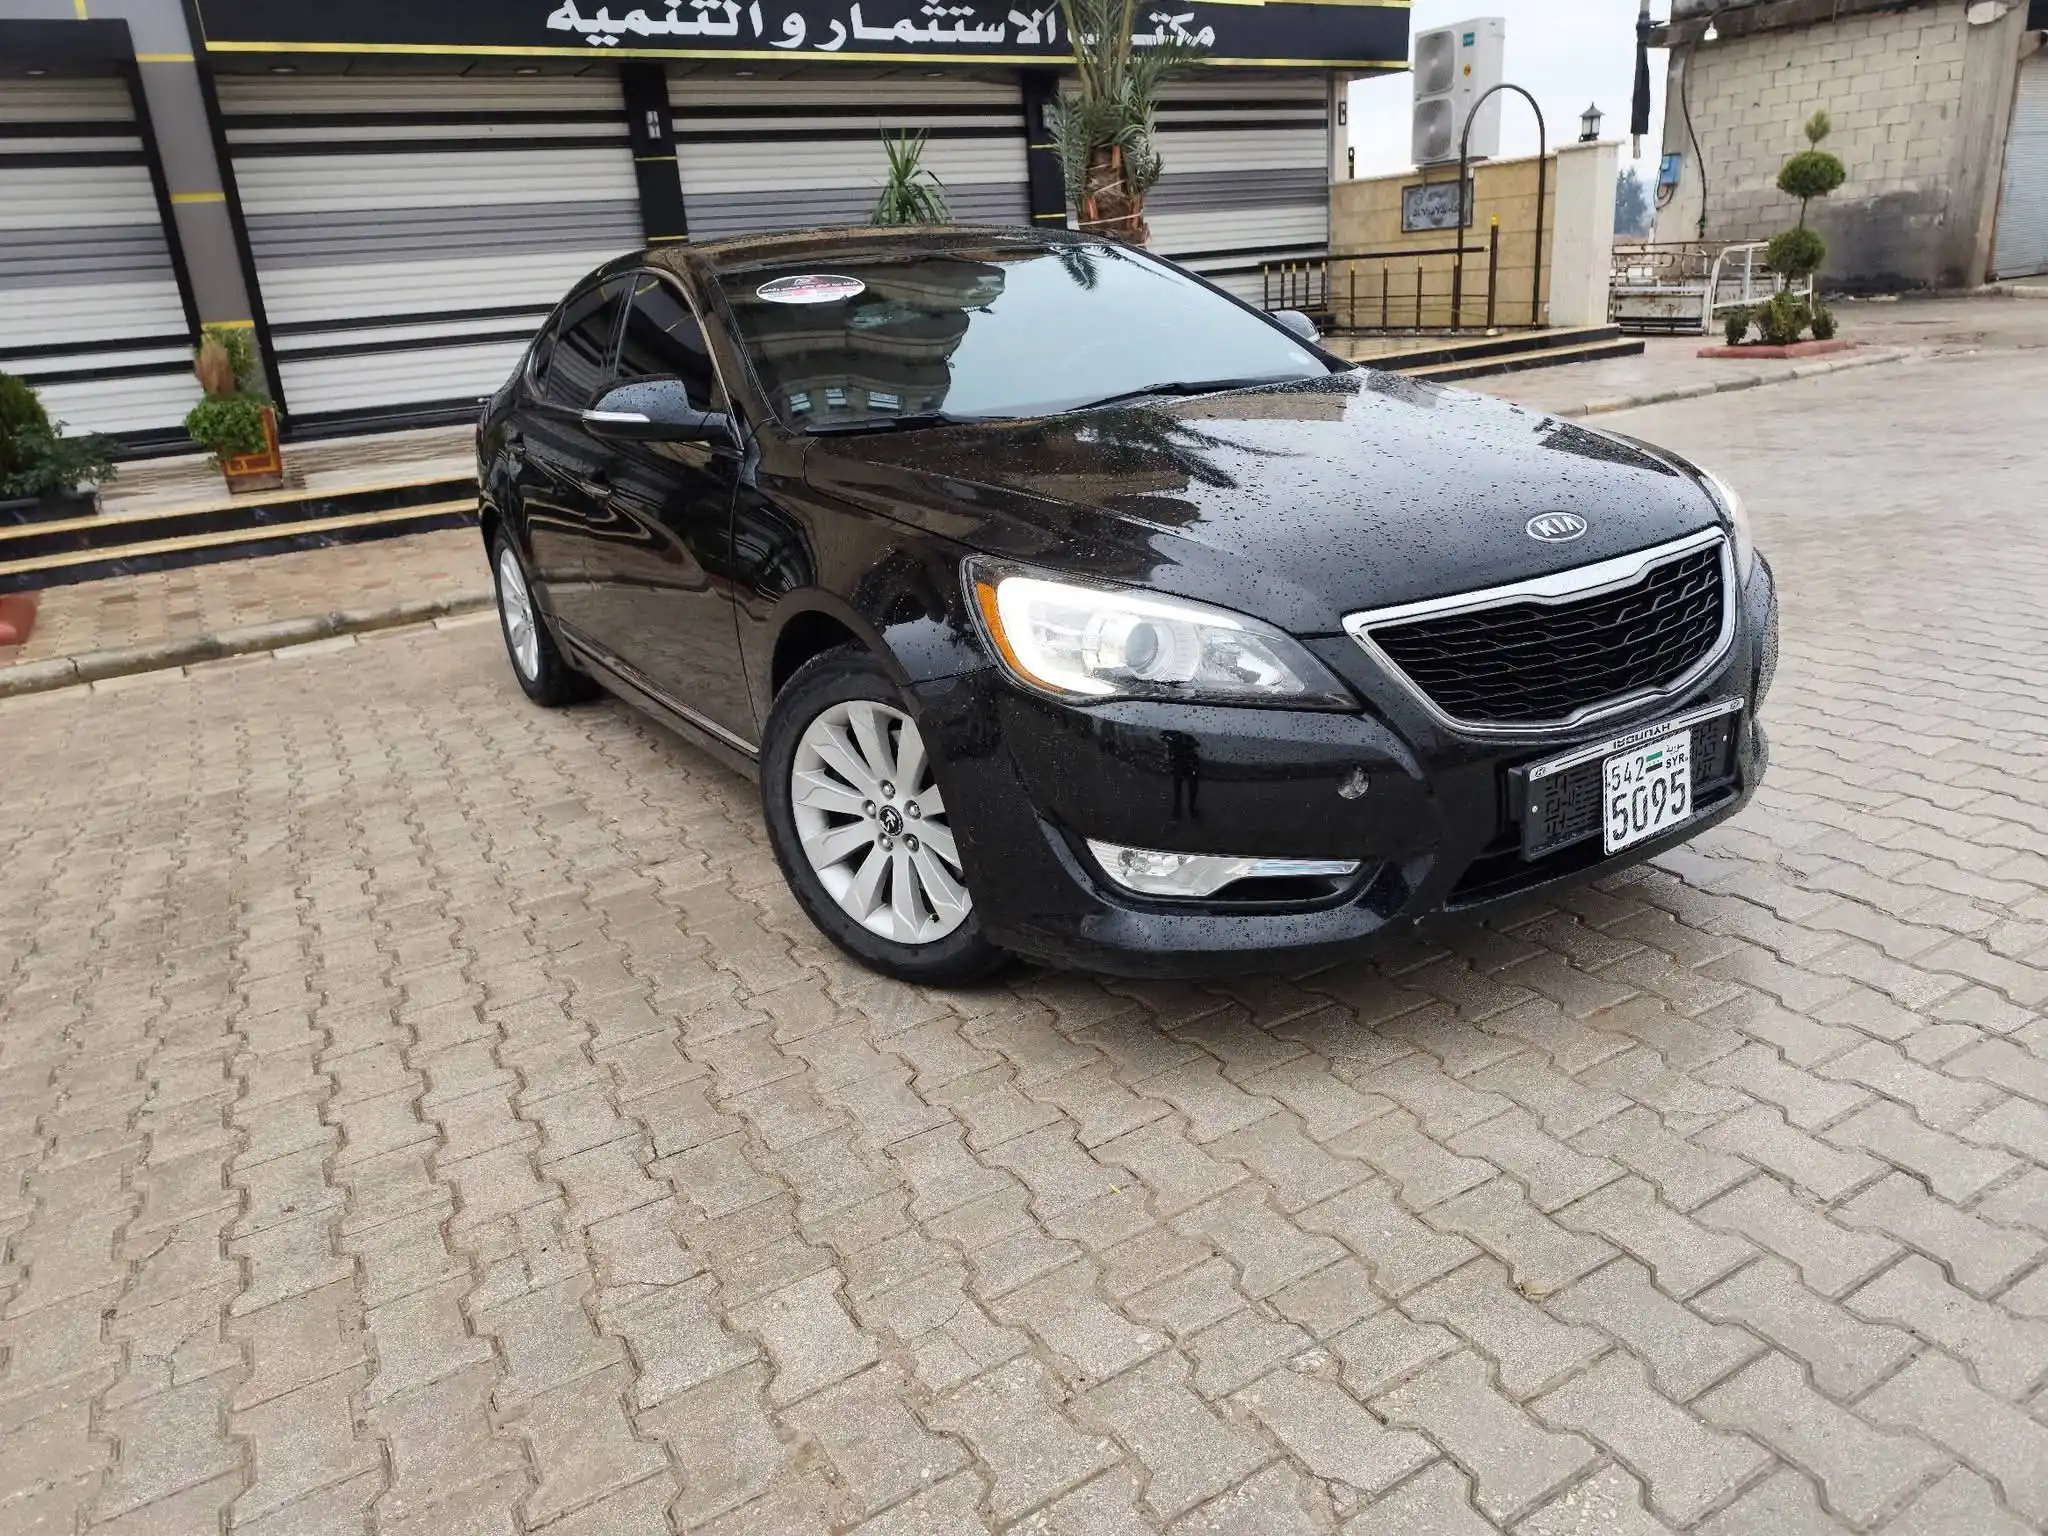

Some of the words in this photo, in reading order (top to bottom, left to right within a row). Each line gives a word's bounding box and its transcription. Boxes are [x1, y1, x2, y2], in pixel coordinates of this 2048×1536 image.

[1534, 515, 1583, 537] KIA
[1611, 756, 1645, 791] 542
[1665, 752, 1685, 769] SYR
[1611, 768, 1686, 841] 5095
